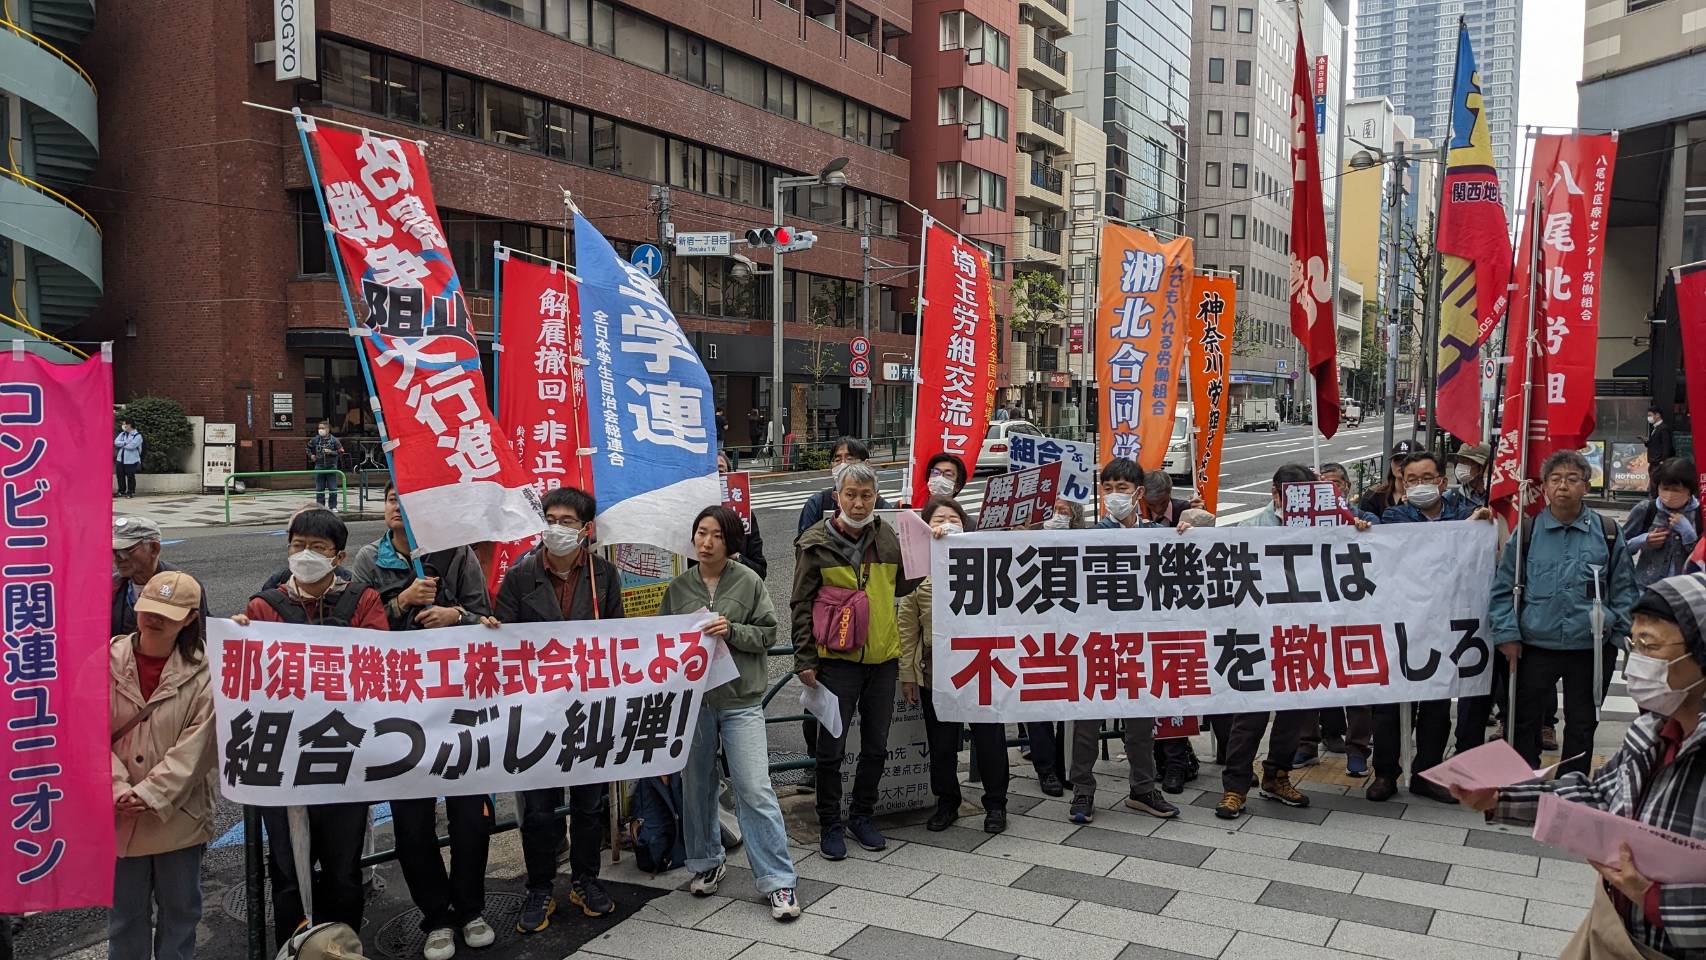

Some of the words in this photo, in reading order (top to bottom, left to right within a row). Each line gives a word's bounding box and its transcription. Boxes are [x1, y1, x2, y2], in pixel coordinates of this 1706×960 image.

[326, 180, 431, 289] 戦争
[678, 235, 728, 246] 新宿一丁目西
[1580, 154, 1608, 320] 八尾北医療センター労働組合
[362, 279, 478, 351] 阻止
[614, 256, 708, 454] 全学連
[854, 341, 866, 352] 40
[939, 245, 979, 454] 埼玉労組交流セ
[592, 309, 624, 467] 全日本学生自治会総連合
[979, 496, 1053, 529] 撤回しろ
[986, 469, 1053, 503] 解雇を
[948, 541, 1377, 616] 那須電機鉄工は
[0, 382, 67, 885] コンビニ関連ユニオン
[840, 607, 851, 647] adidas
[950, 618, 1491, 706] 不当解雇を撤回しろ
[220, 632, 709, 704] 那須電機鉄工株式会社による
[224, 688, 693, 787] 組合つぶし糾弾!
